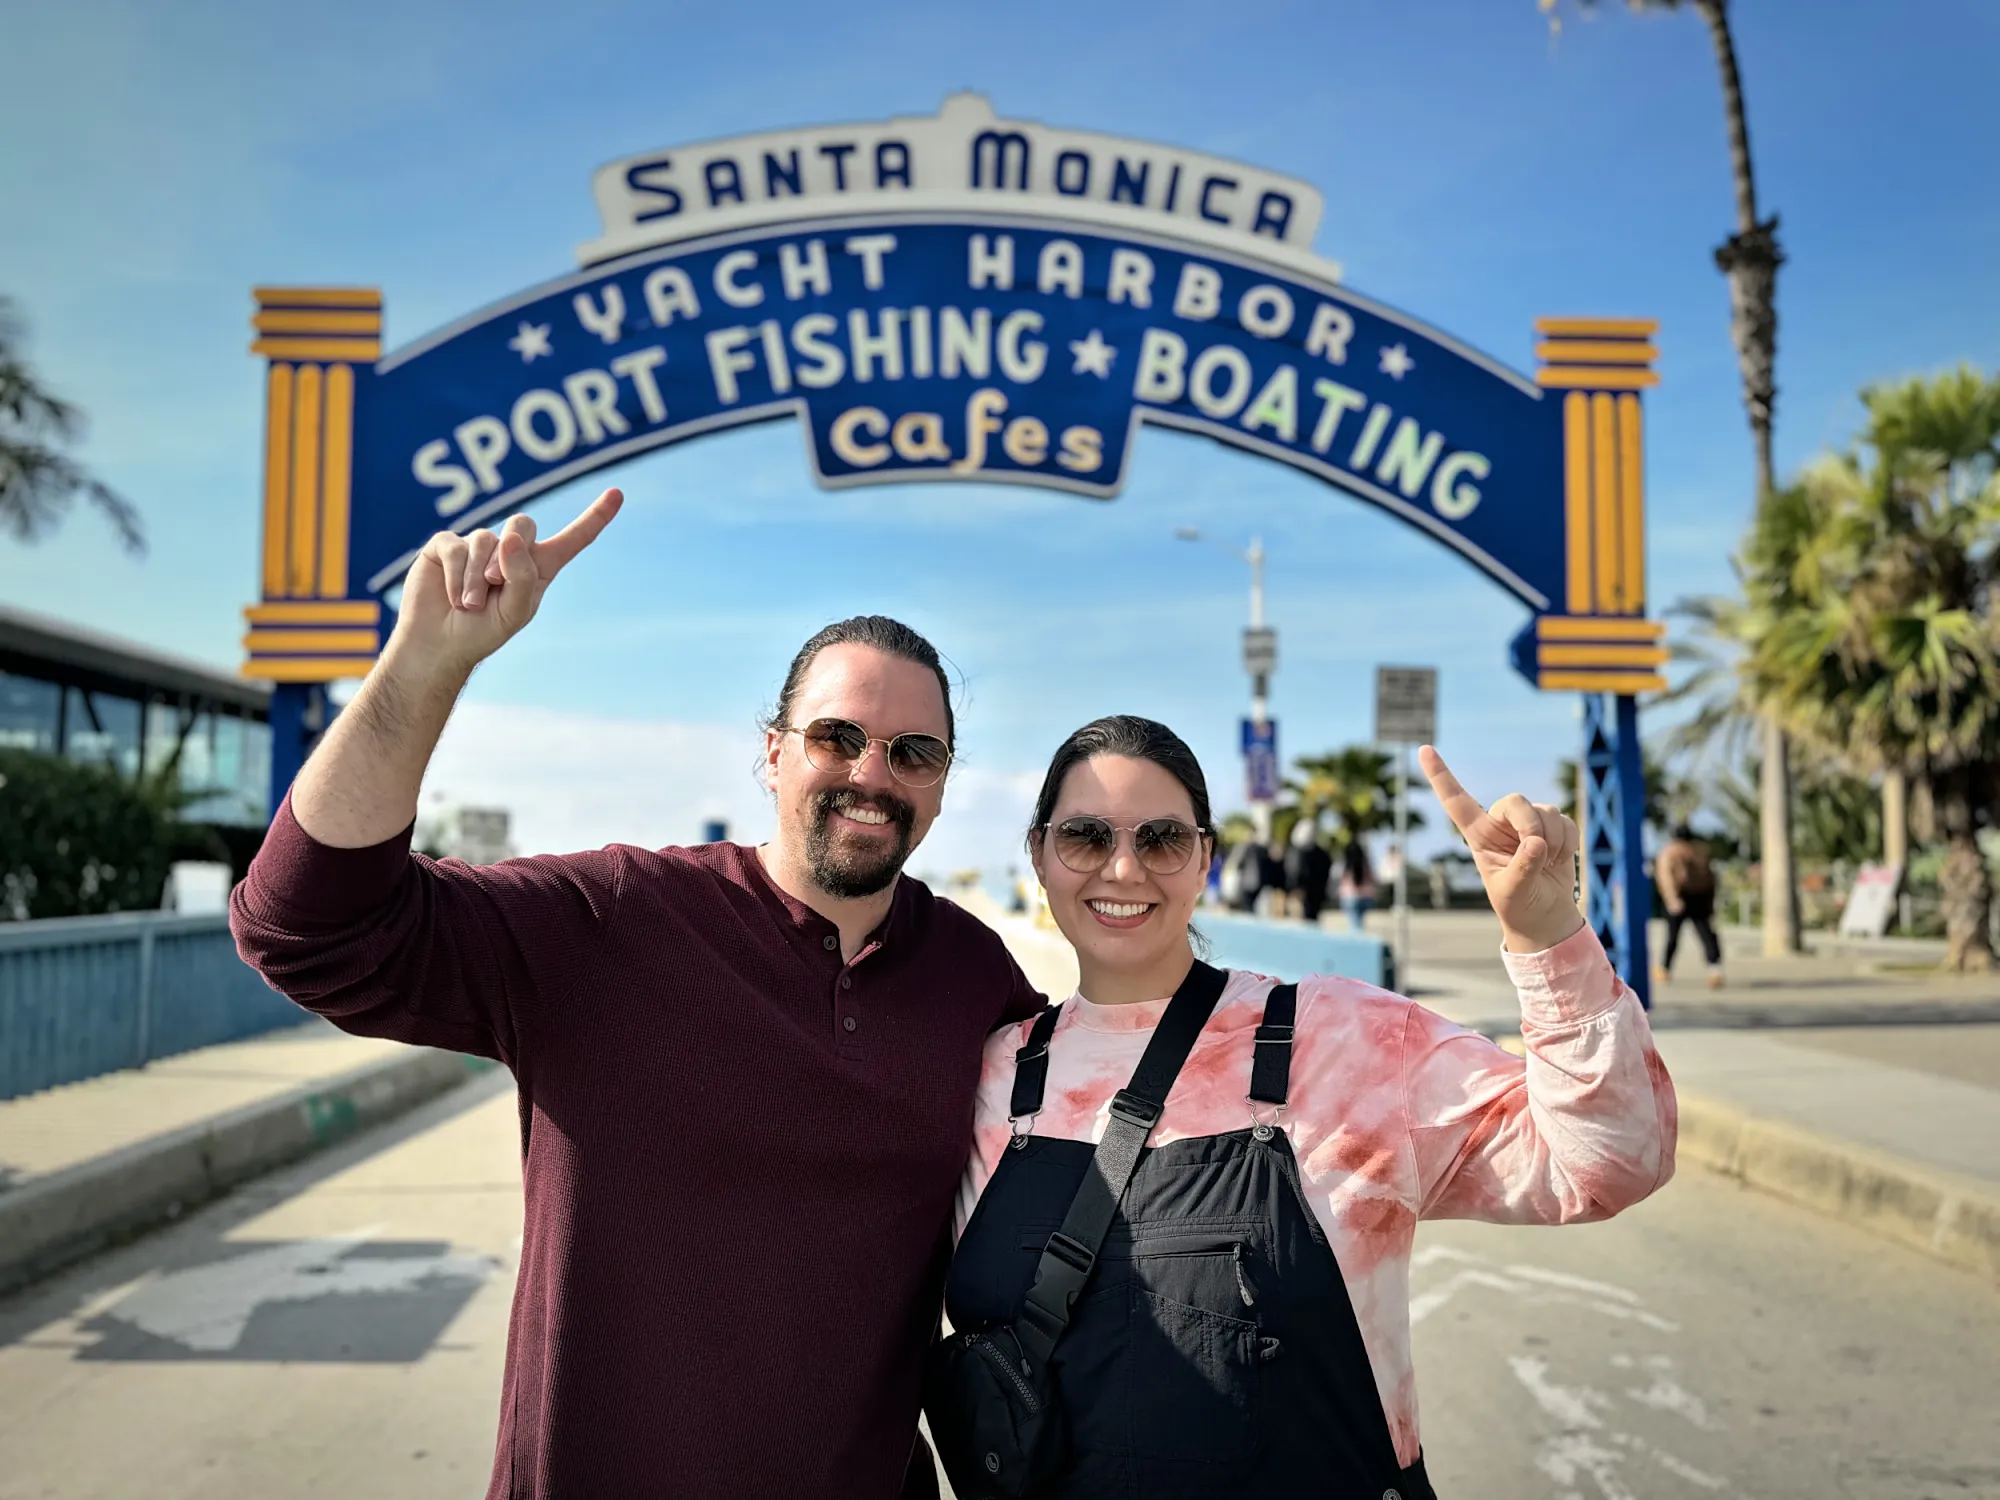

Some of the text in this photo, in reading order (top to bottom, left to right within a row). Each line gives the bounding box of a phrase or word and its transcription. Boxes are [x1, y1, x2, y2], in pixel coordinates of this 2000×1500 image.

[626, 131, 1293, 240] SANTA MONICA
[574, 235, 1354, 365] YACHT HARBOR
[413, 307, 1490, 520] SPORT FISHING BOATING
